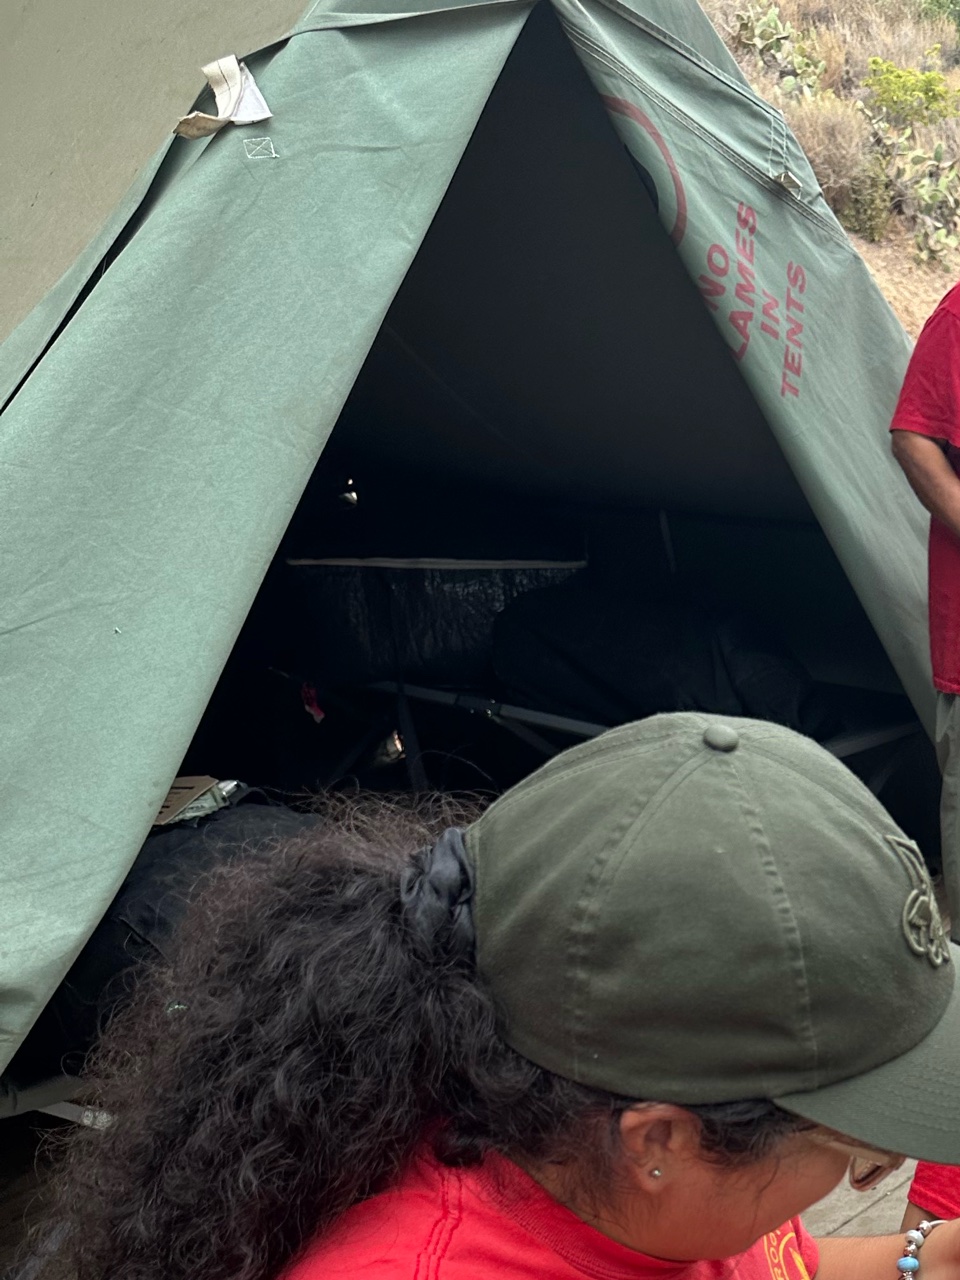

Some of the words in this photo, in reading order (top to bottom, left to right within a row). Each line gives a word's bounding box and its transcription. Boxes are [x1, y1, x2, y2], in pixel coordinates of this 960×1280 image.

[729, 201, 757, 361] LAMES
[760, 290, 780, 339] IN
[781, 261, 807, 398] TENTS
